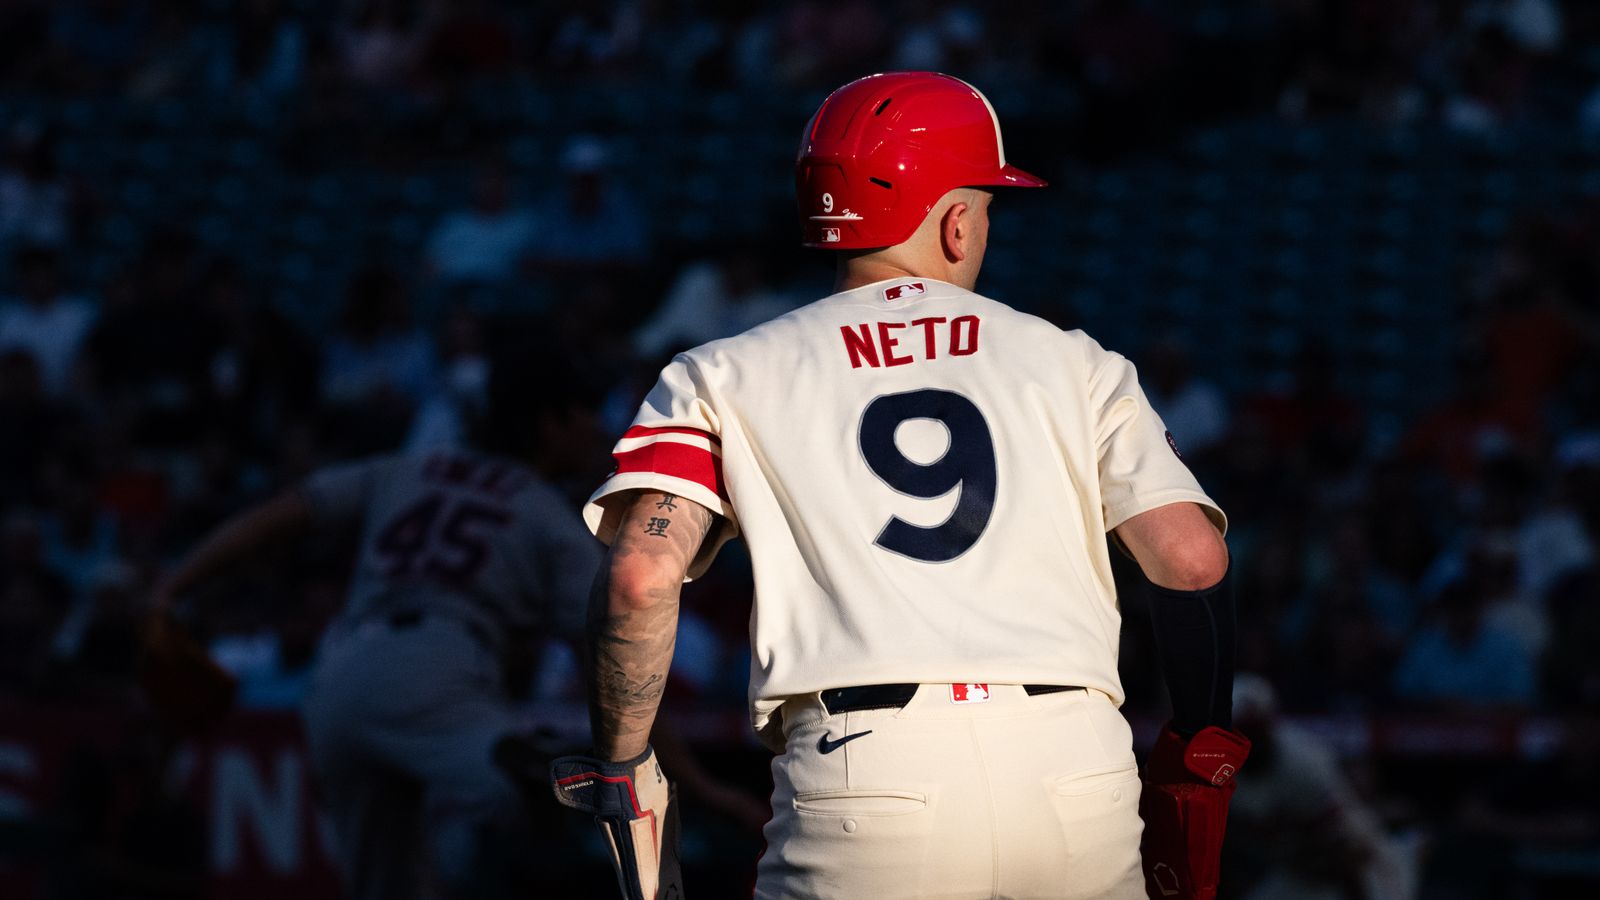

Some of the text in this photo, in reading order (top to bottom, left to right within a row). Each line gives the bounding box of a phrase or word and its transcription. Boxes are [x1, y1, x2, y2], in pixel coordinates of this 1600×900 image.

[822, 192, 834, 213] 9
[840, 315, 981, 369] NETO
[856, 387, 1000, 564] 9
[375, 494, 513, 587] 45
[564, 780, 594, 791] EVOSHIELD
